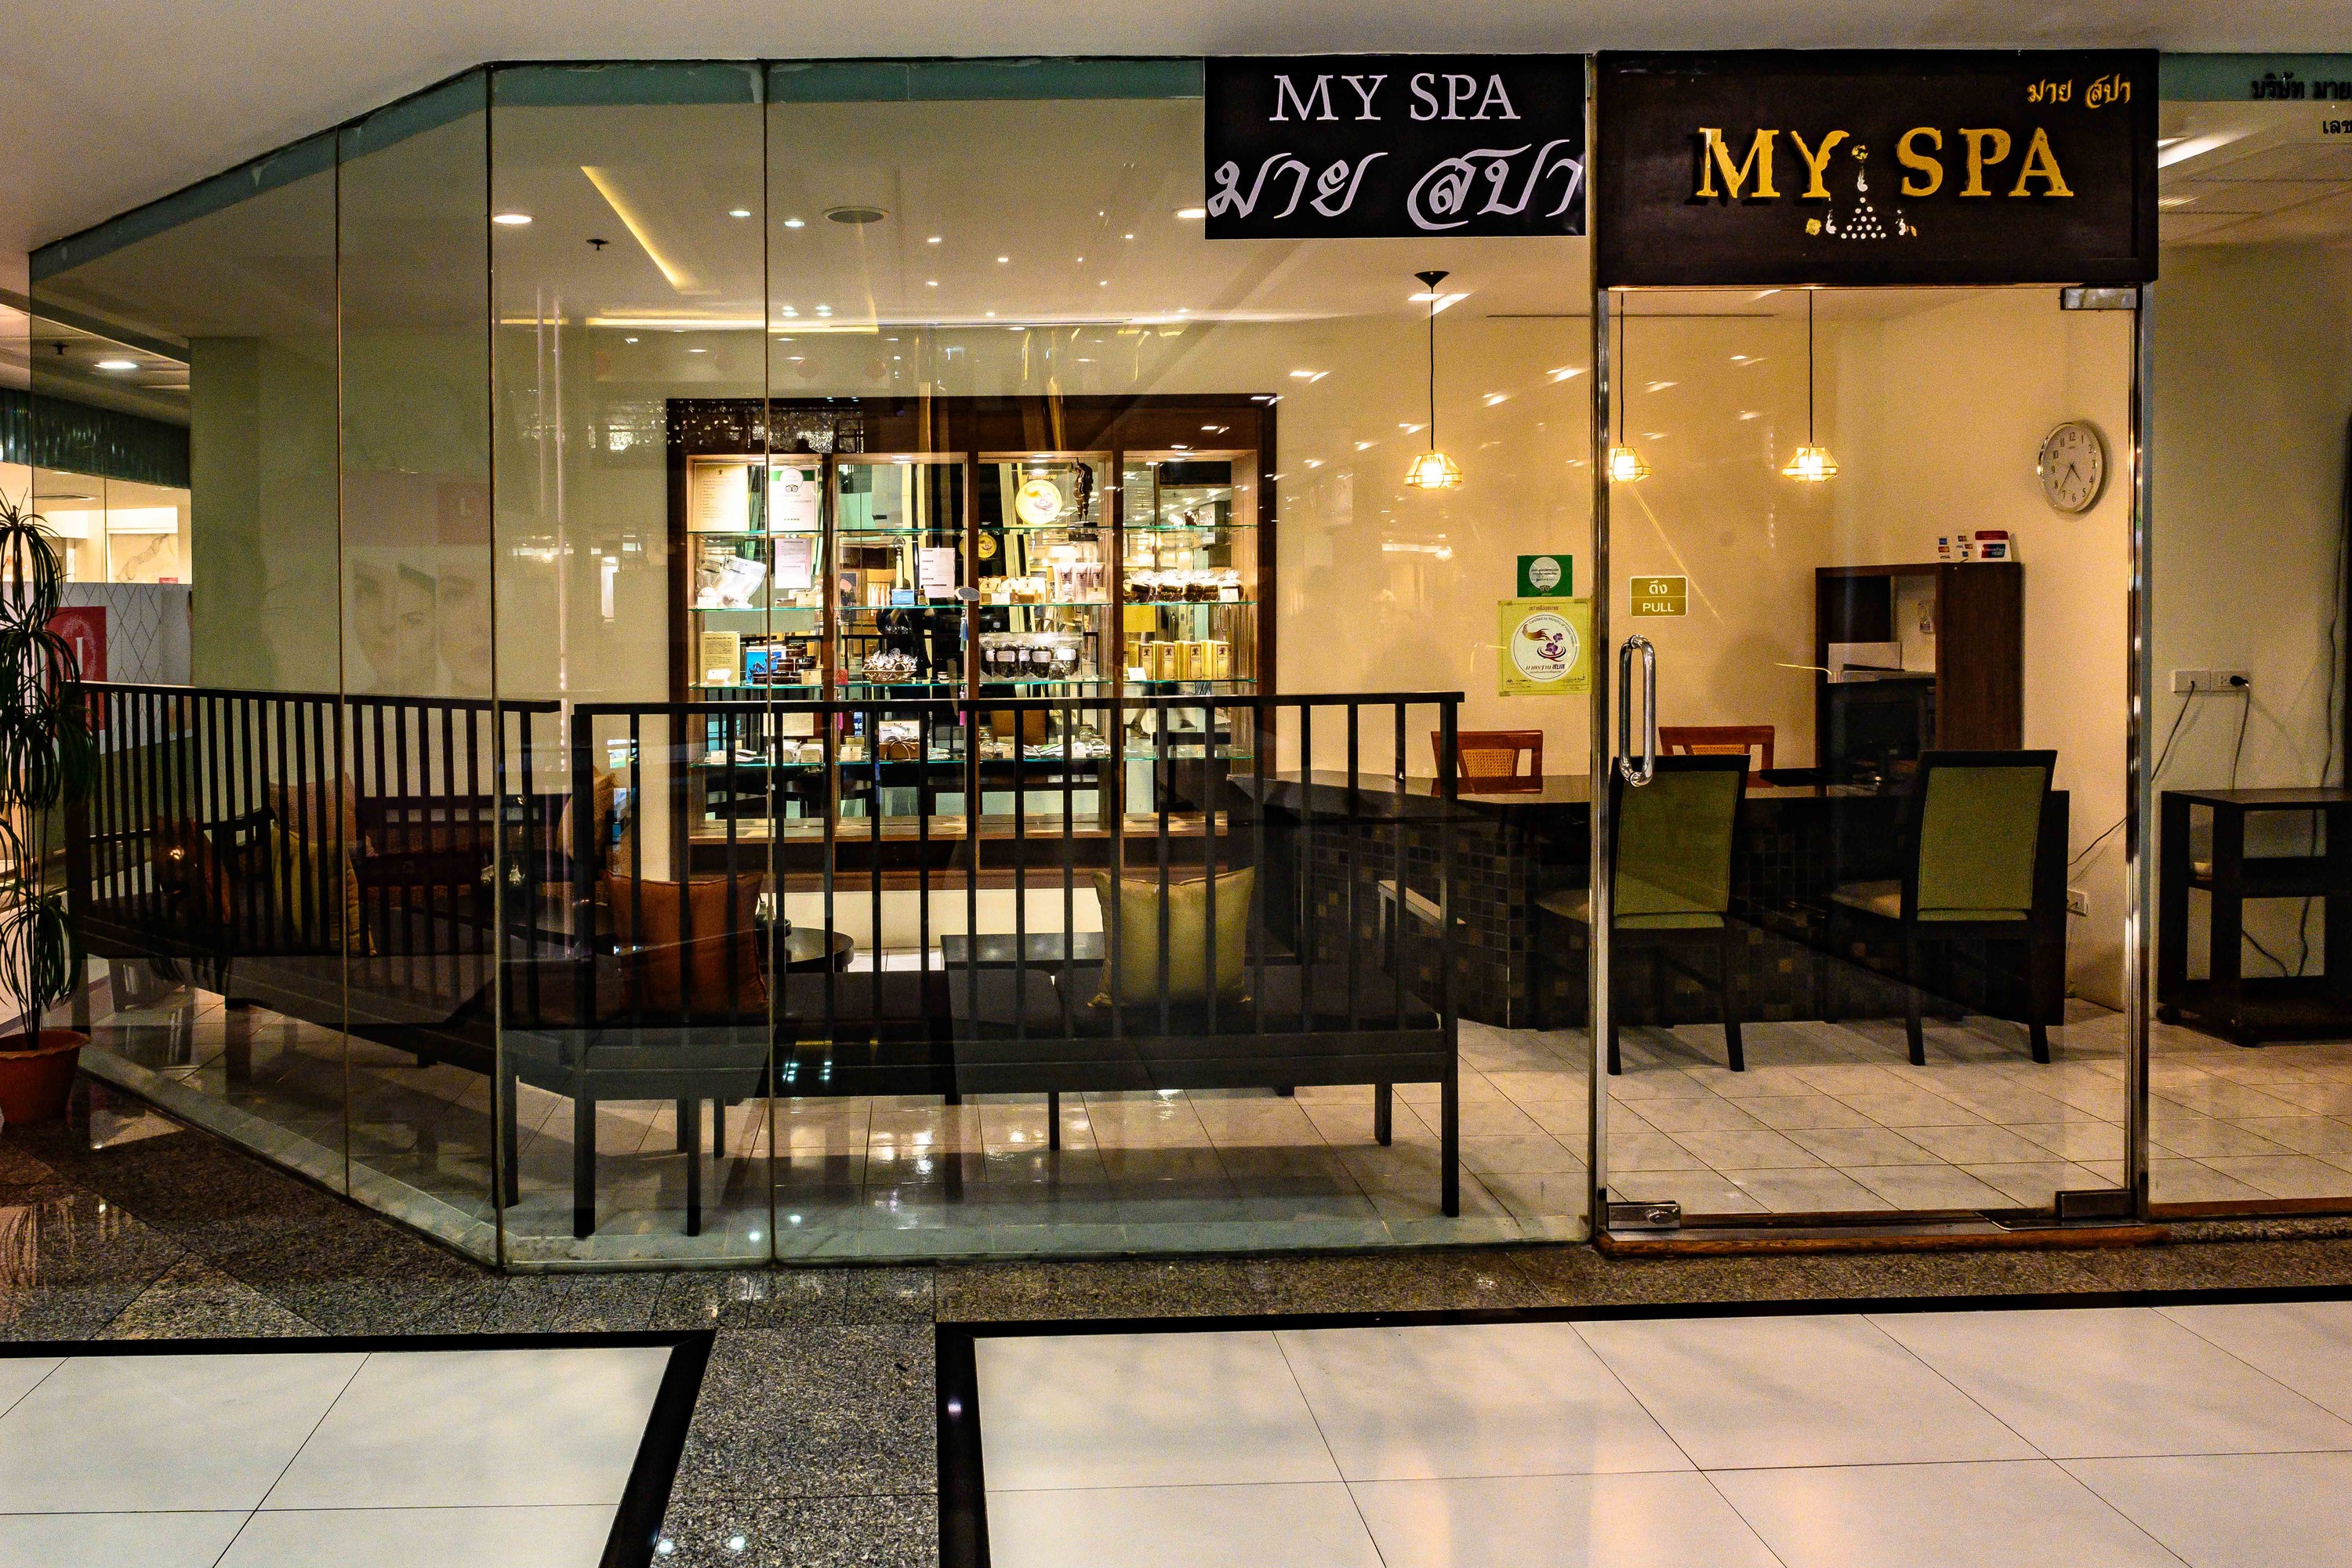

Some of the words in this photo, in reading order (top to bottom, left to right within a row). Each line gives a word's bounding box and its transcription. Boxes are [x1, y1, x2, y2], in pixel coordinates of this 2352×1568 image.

[1269, 74, 1388, 121] MY
[1410, 72, 1521, 121] SPA
[2027, 78, 2073, 105] มาย
[2084, 73, 2131, 109] สปา
[2252, 71, 2306, 100] บริษัท
[1695, 126, 1850, 199] MY
[1895, 126, 2074, 198] SPA
[1207, 152, 1388, 219] มาย
[1407, 139, 1584, 230] สปา
[2069, 431, 2076, 441] 12
[1649, 579, 1668, 594] ดึง
[1642, 602, 1675, 612] PULL
